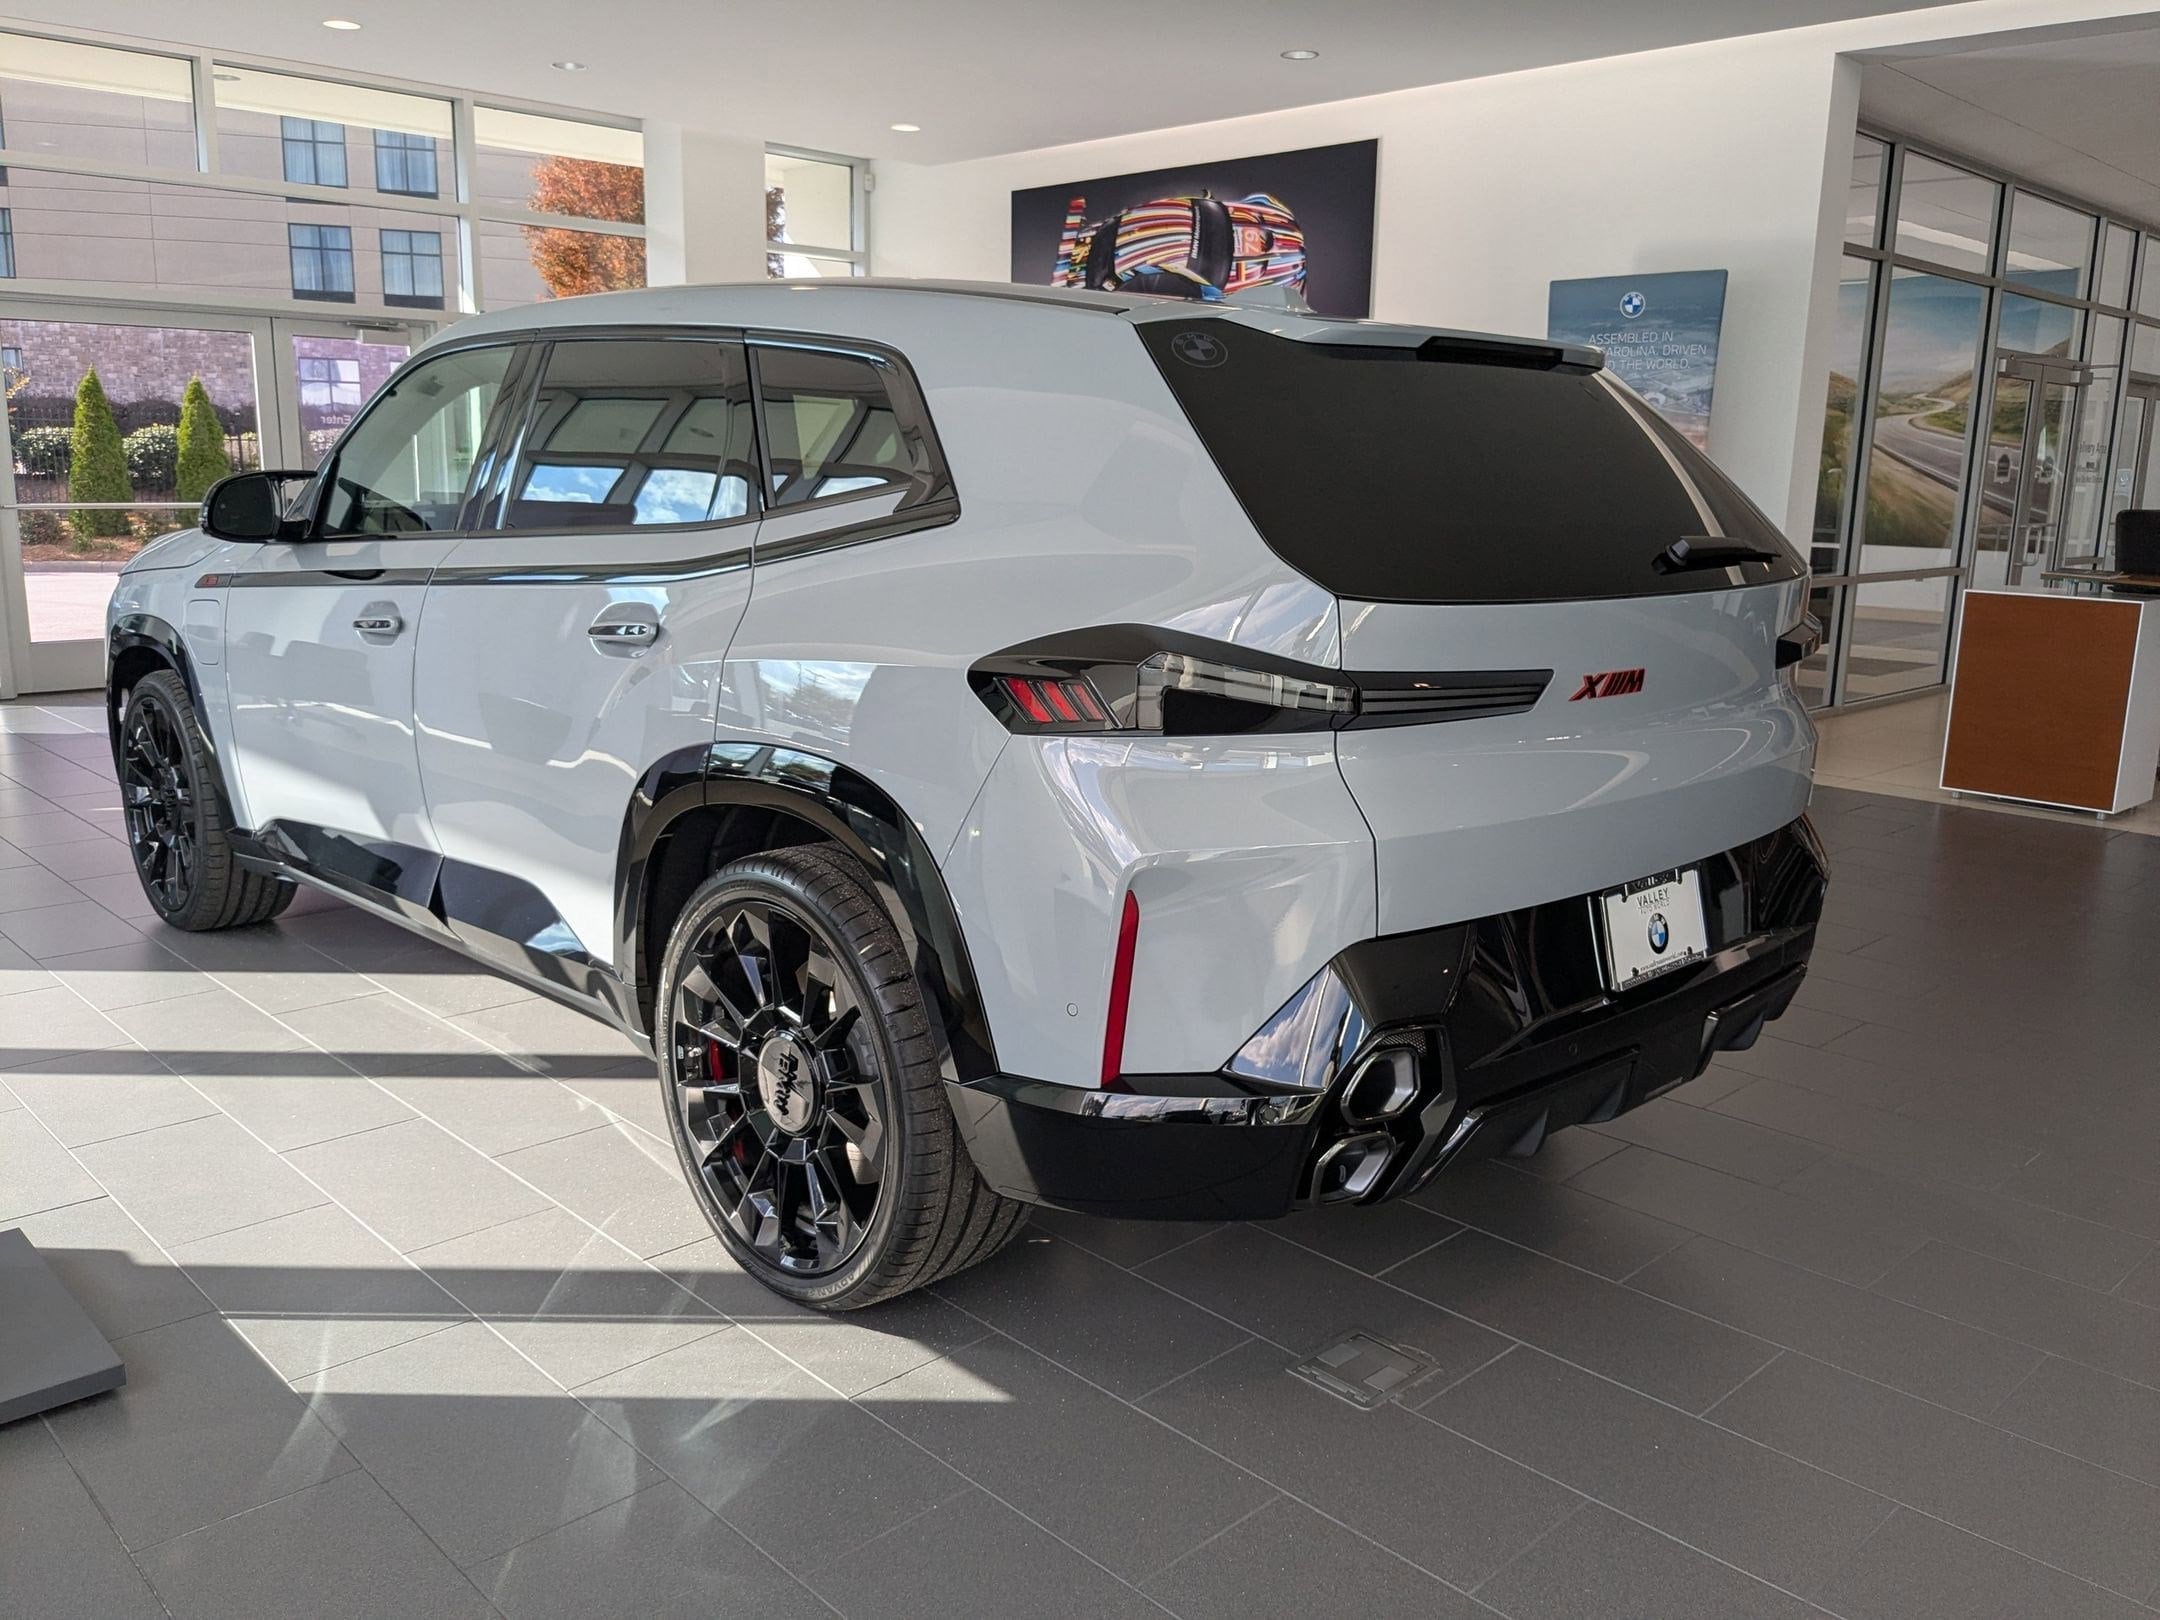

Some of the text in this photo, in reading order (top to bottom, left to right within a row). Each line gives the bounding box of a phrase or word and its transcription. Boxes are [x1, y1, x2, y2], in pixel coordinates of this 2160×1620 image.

[1588, 331, 1674, 345] ASSEMBLED IN
[1662, 344, 1707, 356] DRIVEN
[1620, 359, 1642, 370] THE
[1646, 358, 1690, 370] WORLD.
[1637, 887, 1669, 906] VALLEY
